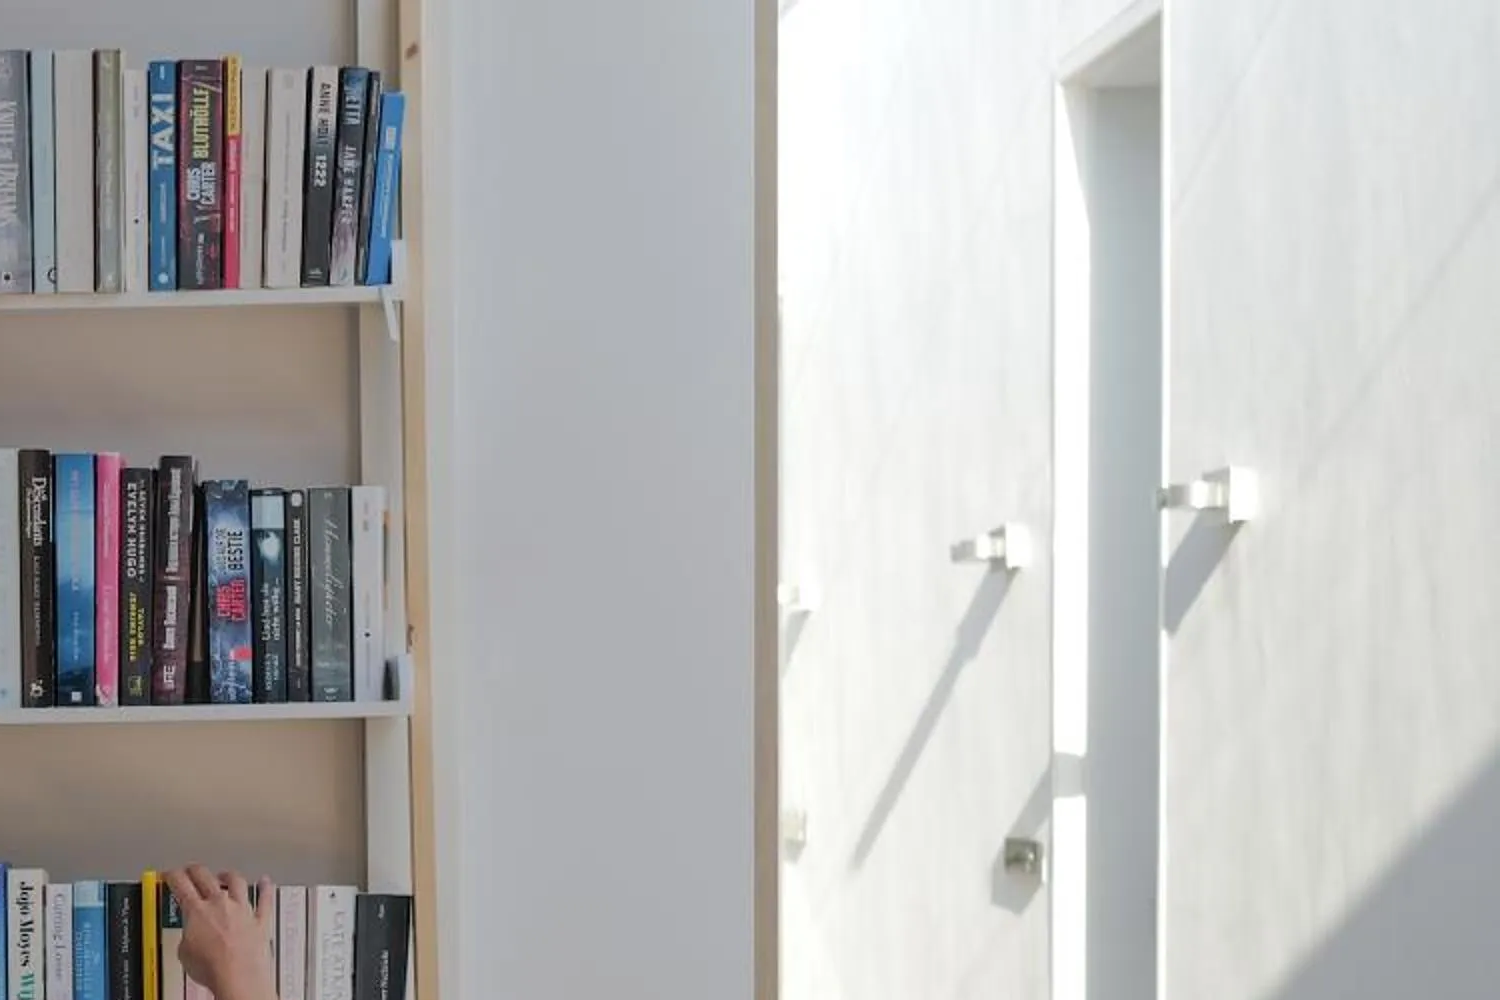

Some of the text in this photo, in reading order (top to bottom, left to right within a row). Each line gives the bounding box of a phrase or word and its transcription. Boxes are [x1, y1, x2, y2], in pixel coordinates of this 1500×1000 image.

[189, 87, 211, 159] BLUTHÖLLE
[316, 81, 332, 113] ANNE
[152, 93, 174, 171] TAXI
[186, 168, 201, 200] CHRIS
[200, 161, 217, 205] CARTER
[313, 154, 328, 188] 1222
[31, 476, 47, 546] Descendants
[126, 482, 137, 578] EVELYN HUGO
[228, 531, 244, 571] BESTIE
[15, 881, 35, 967] Jojo Moyes
